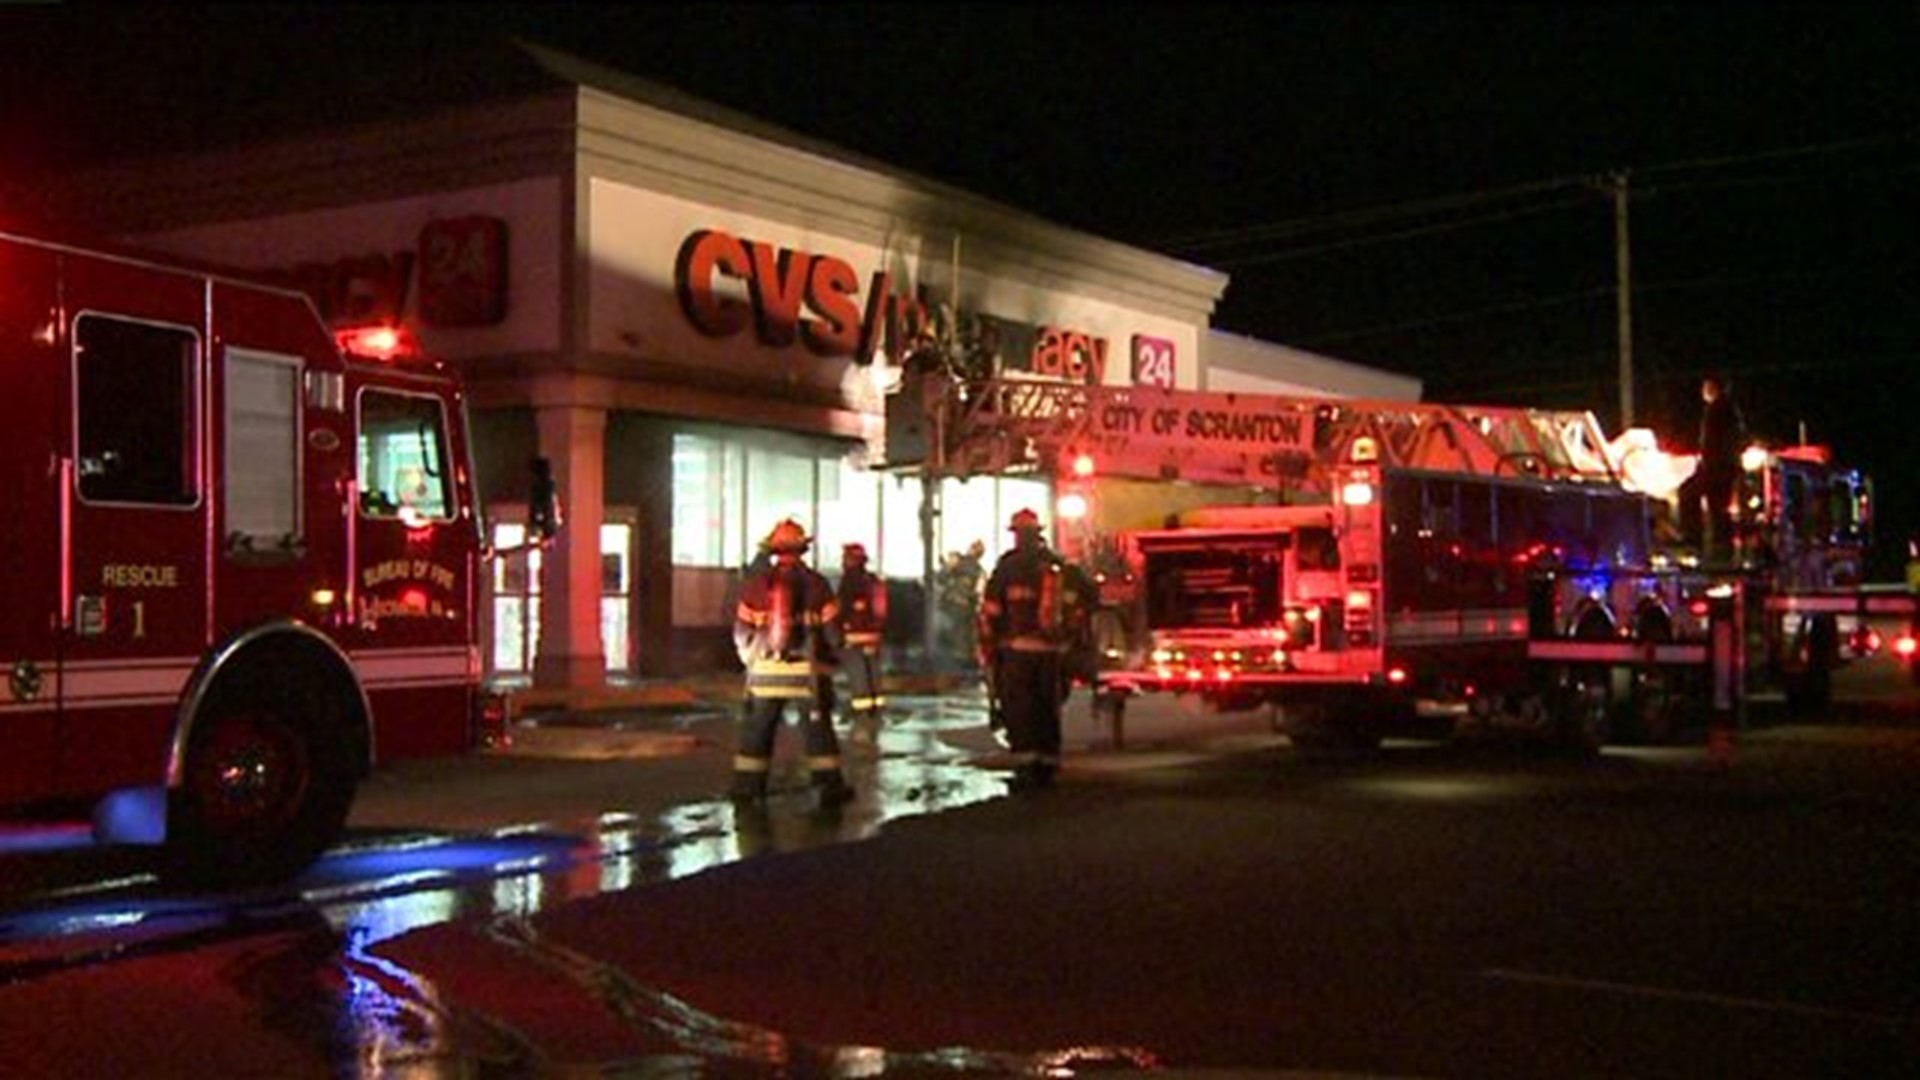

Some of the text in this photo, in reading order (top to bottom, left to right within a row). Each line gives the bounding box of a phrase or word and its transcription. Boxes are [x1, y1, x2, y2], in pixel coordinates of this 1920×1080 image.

[1138, 344, 1173, 387] 24
[1102, 406, 1301, 445] CITY OF SCRANTON
[103, 565, 180, 588] RESCUE
[132, 601, 145, 637] 1
